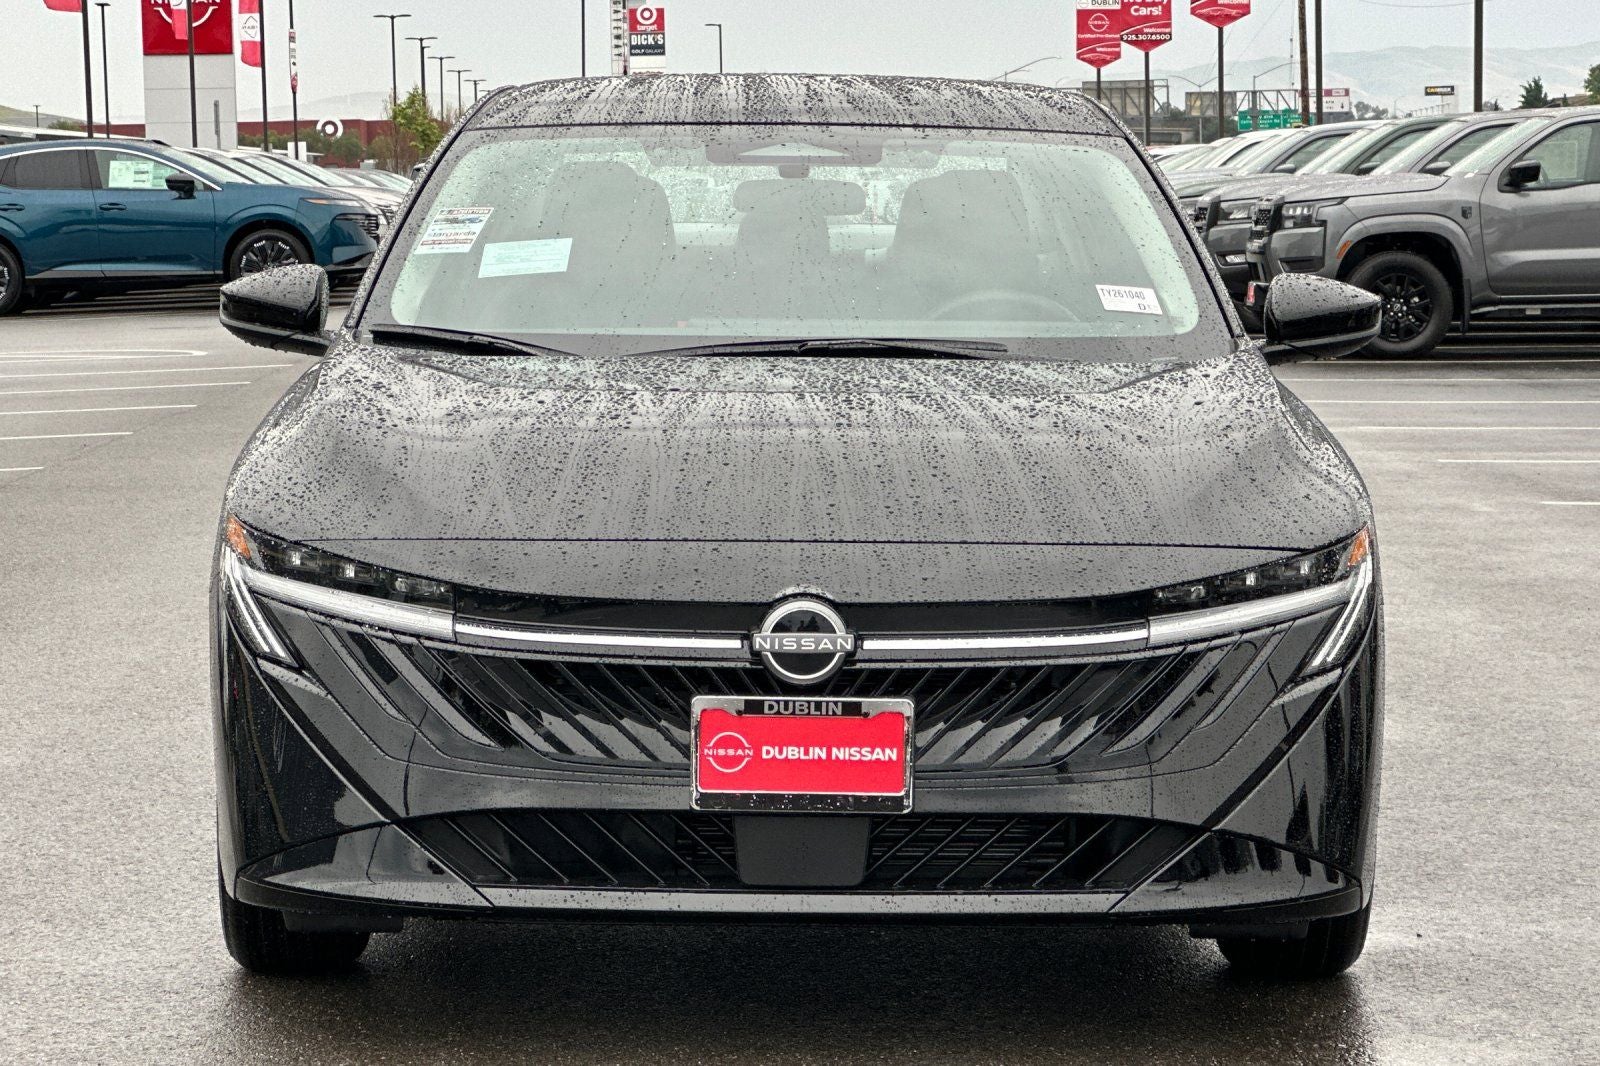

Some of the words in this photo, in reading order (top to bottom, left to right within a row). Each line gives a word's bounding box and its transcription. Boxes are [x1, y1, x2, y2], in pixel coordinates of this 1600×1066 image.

[1130, 6, 1163, 16] Cars!
[613, 0, 622, 57] GATEWAY
[631, 34, 664, 45] DICK'S
[1100, 288, 1146, 300] TY261040
[755, 637, 851, 650] NISSAN
[763, 701, 843, 715] DUBLIN
[704, 748, 753, 756] NISSAN
[762, 746, 827, 760] DUBLIN
[831, 747, 897, 761] NISSAN
